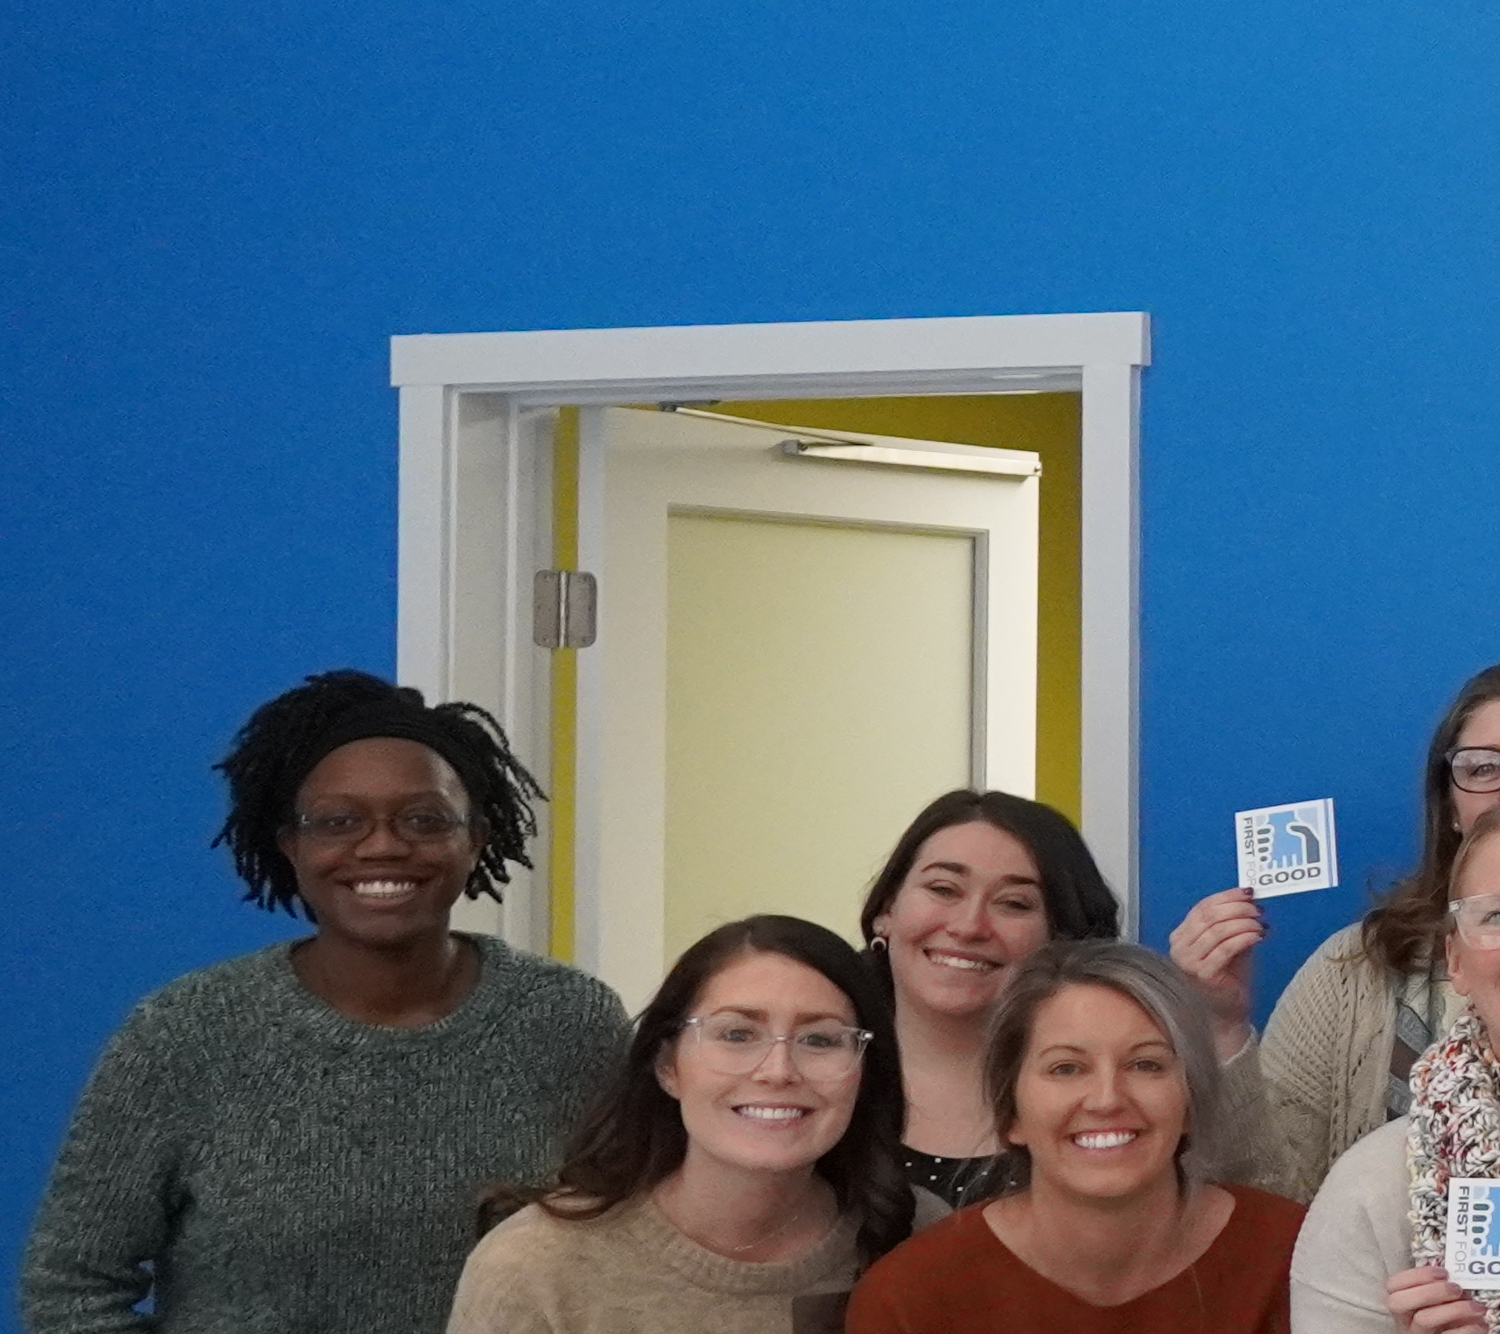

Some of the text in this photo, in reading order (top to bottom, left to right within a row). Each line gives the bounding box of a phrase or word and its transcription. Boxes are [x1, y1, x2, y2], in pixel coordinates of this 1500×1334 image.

[1243, 817, 1256, 887] FIRST FOR
[1258, 867, 1321, 886] GOOD
[1454, 1186, 1470, 1273] FIRST FOR
